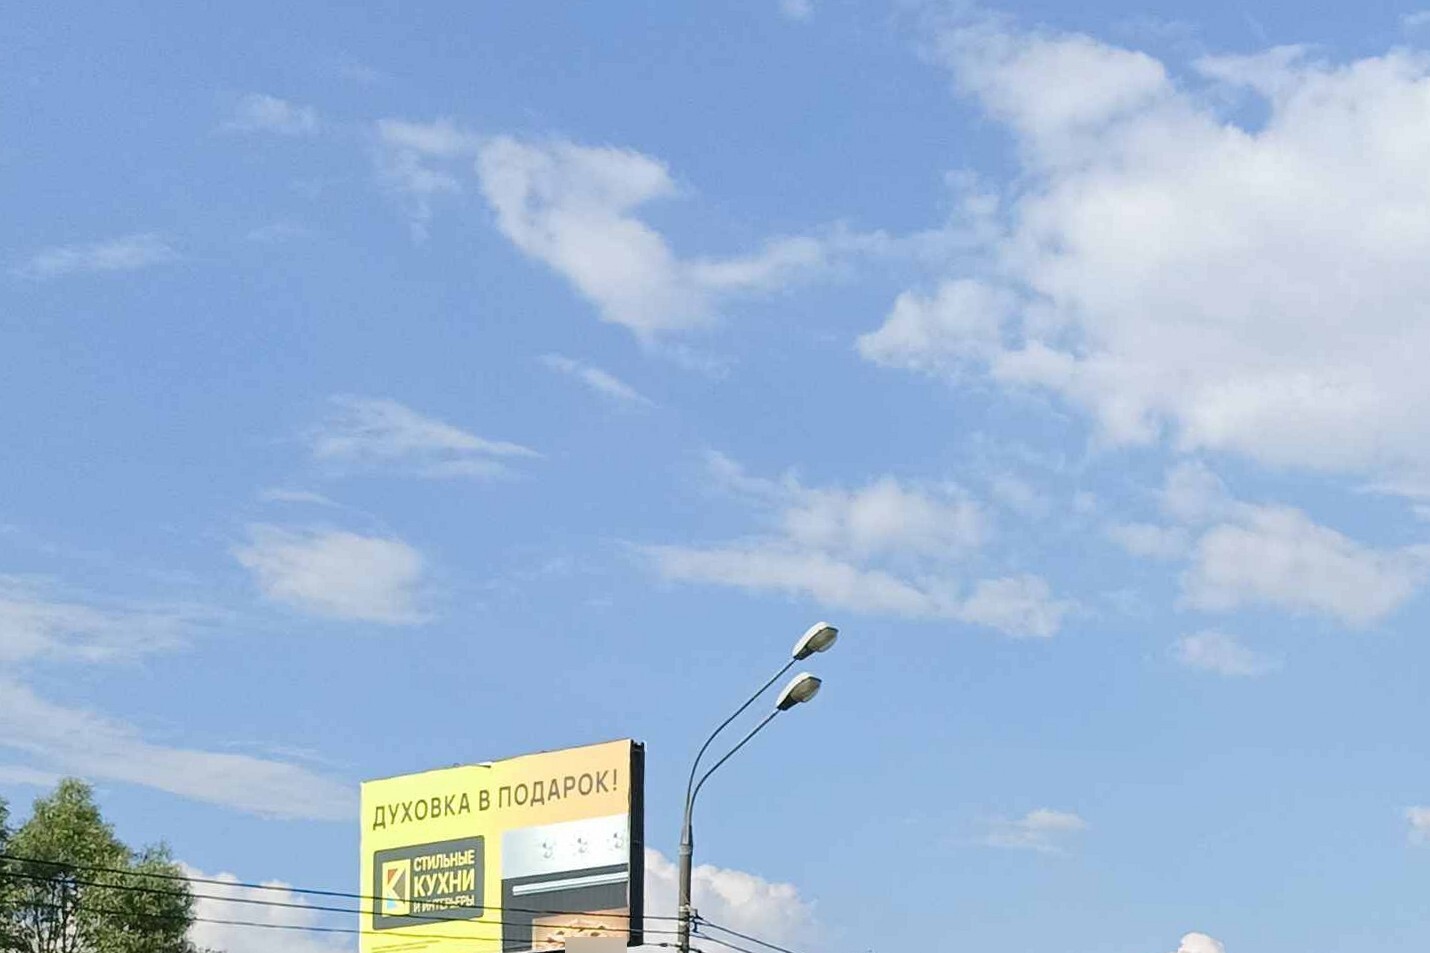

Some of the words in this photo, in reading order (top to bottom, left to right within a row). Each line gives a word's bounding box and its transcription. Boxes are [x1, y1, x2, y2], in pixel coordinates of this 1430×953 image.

[372, 793, 471, 831] ДУХОВКА
[478, 789, 491, 812] В
[498, 768, 618, 809] ПОДАРОК!
[413, 849, 475, 872] СТИЛЬНЫЕ
[413, 868, 475, 898] КУХНИ
